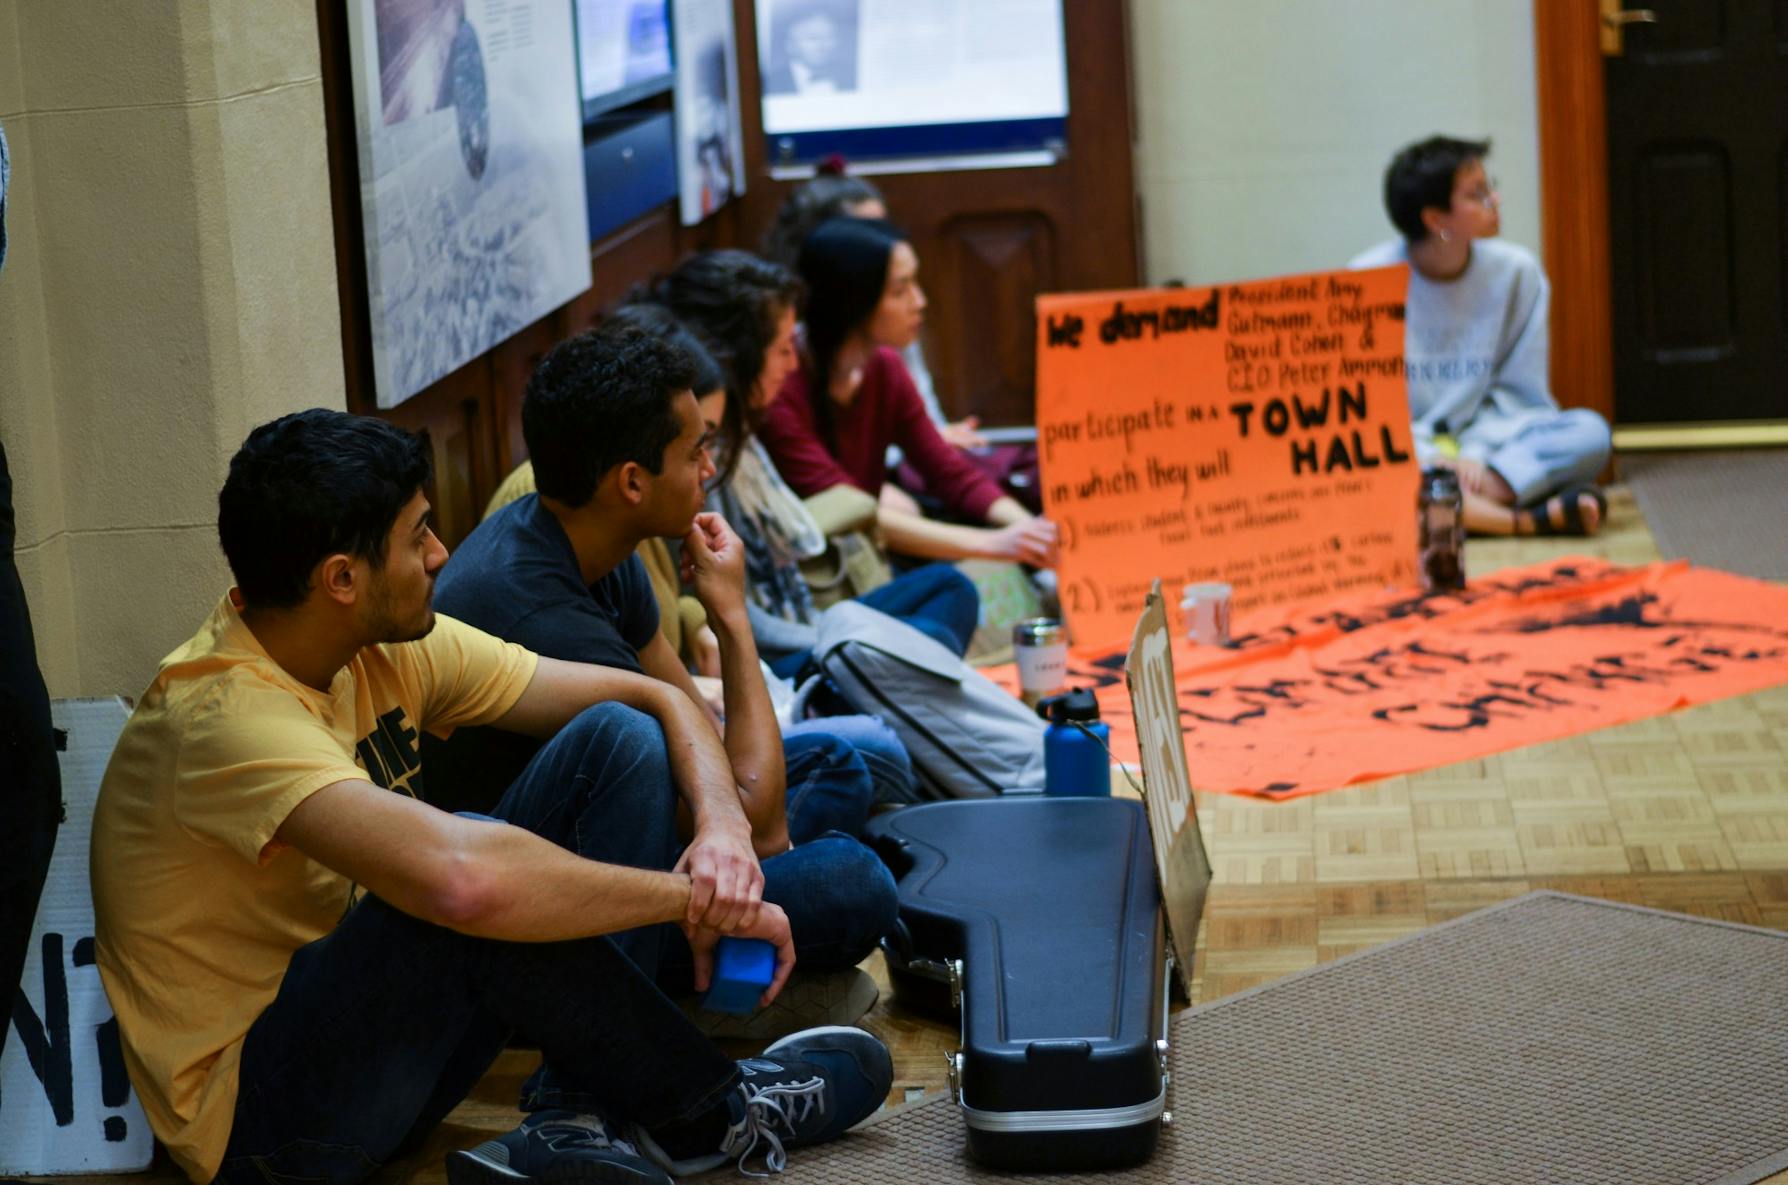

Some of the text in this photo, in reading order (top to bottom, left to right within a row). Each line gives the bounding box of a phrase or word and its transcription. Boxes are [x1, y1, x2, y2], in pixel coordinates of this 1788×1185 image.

[1047, 288, 1220, 348] We demand
[1279, 361, 1330, 389] Peter
[1044, 397, 1175, 464] participate
[1229, 382, 1366, 438] TOWN
[1291, 424, 1409, 476] HALL
[1075, 466, 1139, 499] which
[1146, 455, 1189, 502] they
[1196, 448, 1230, 480] will
